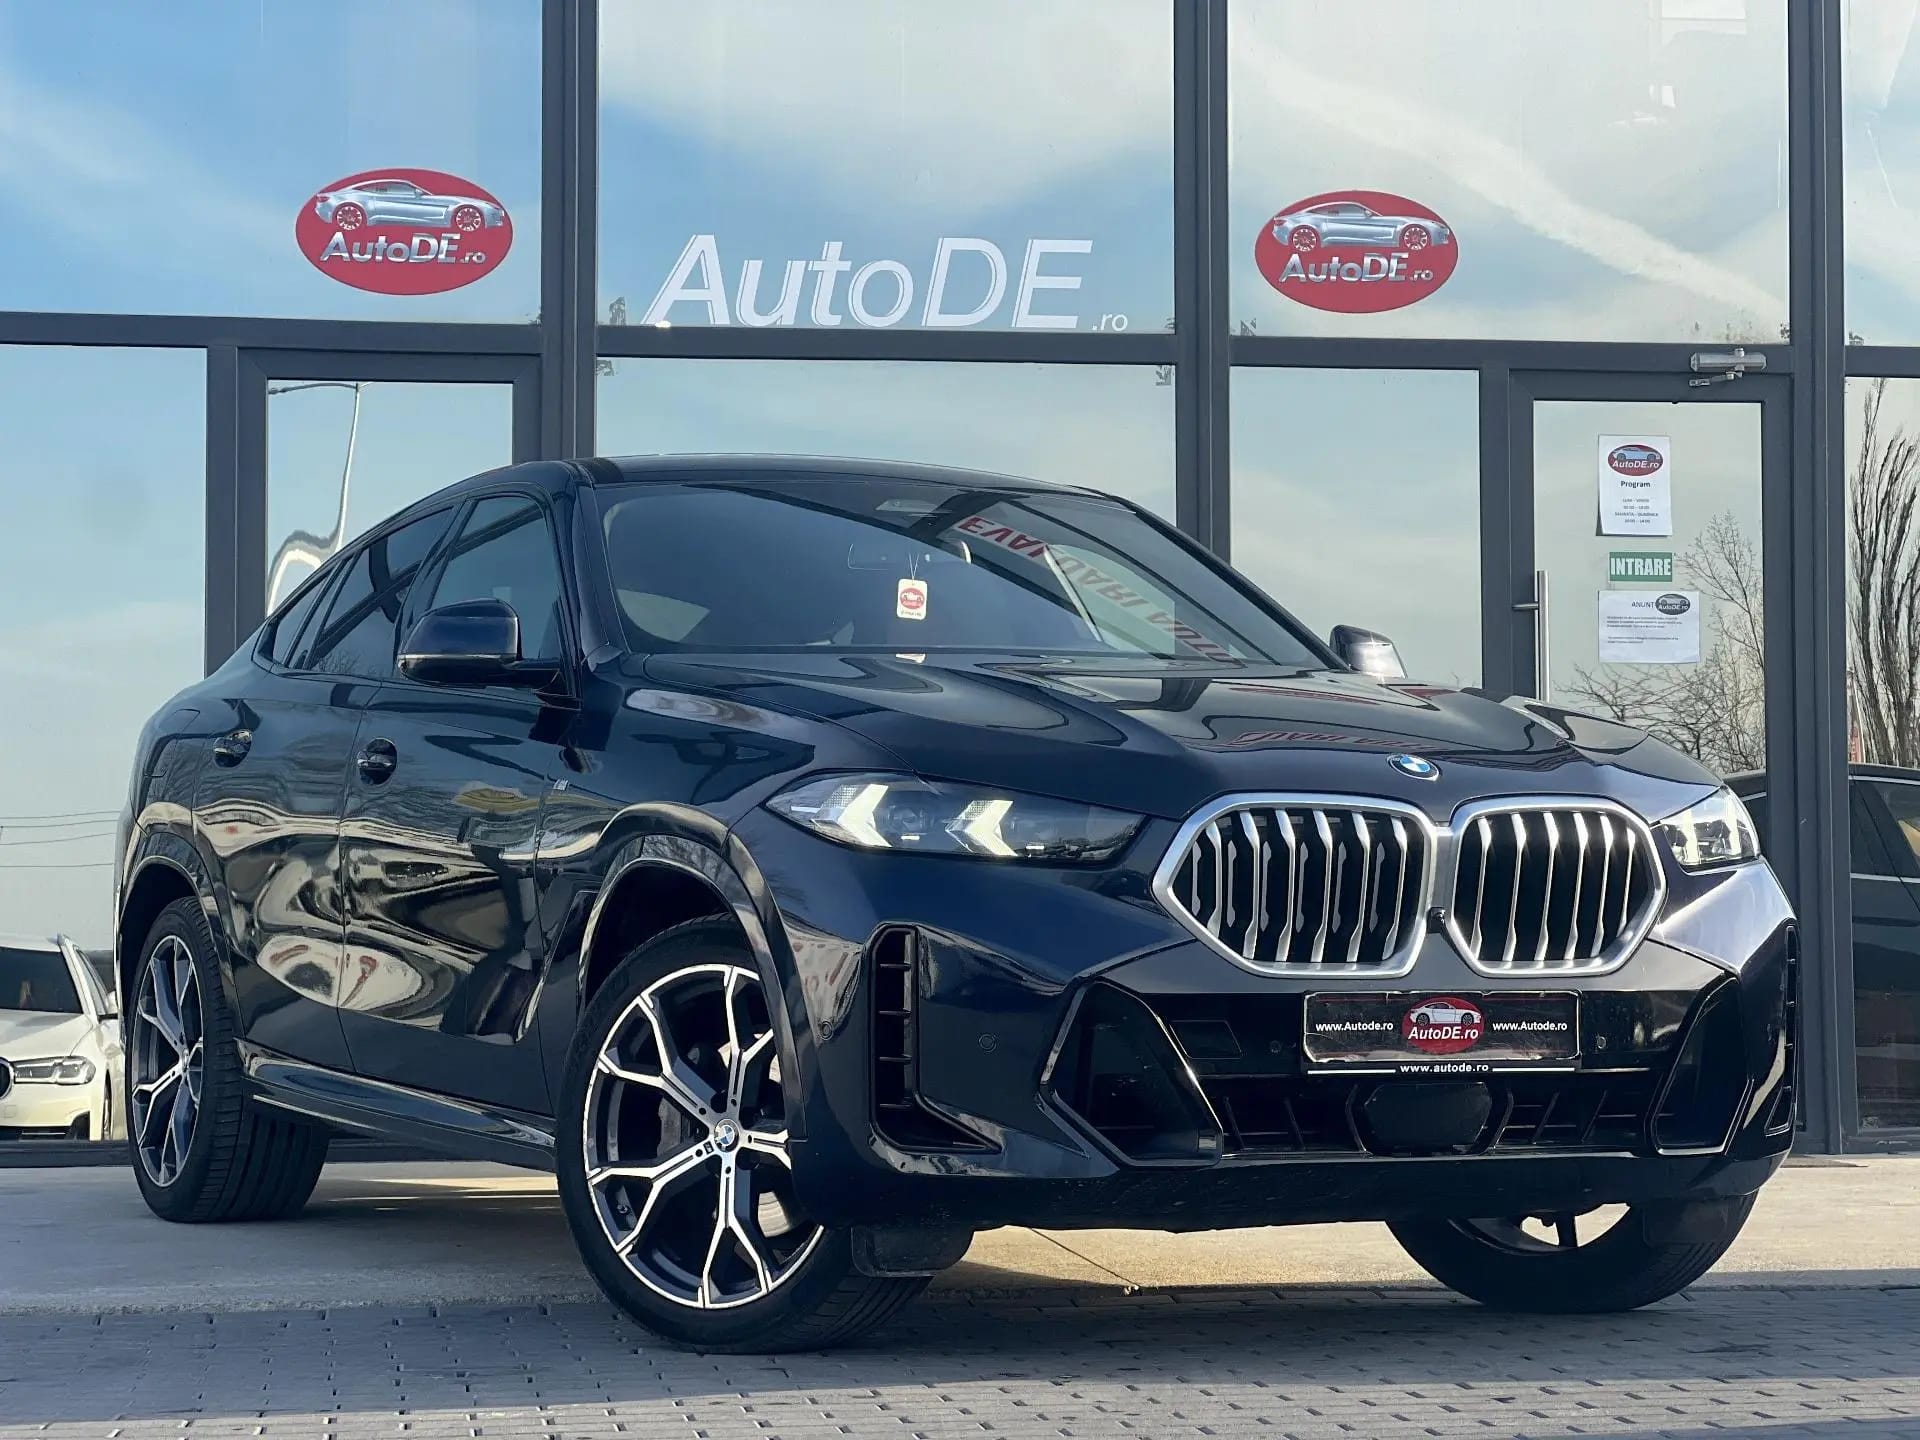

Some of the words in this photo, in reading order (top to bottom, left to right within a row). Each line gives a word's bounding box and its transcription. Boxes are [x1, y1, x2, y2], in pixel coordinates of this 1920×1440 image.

[1612, 460, 1660, 469] AutoDE.ro
[1620, 480, 1651, 489] Program
[1610, 557, 1672, 576] INTRARE
[1315, 1020, 1394, 1032] www.Autode.ro
[1492, 1020, 1568, 1032] www.Autode.ro
[1407, 1026, 1479, 1041] AutoDE.ro
[1400, 1062, 1489, 1073] www.autode.ro
